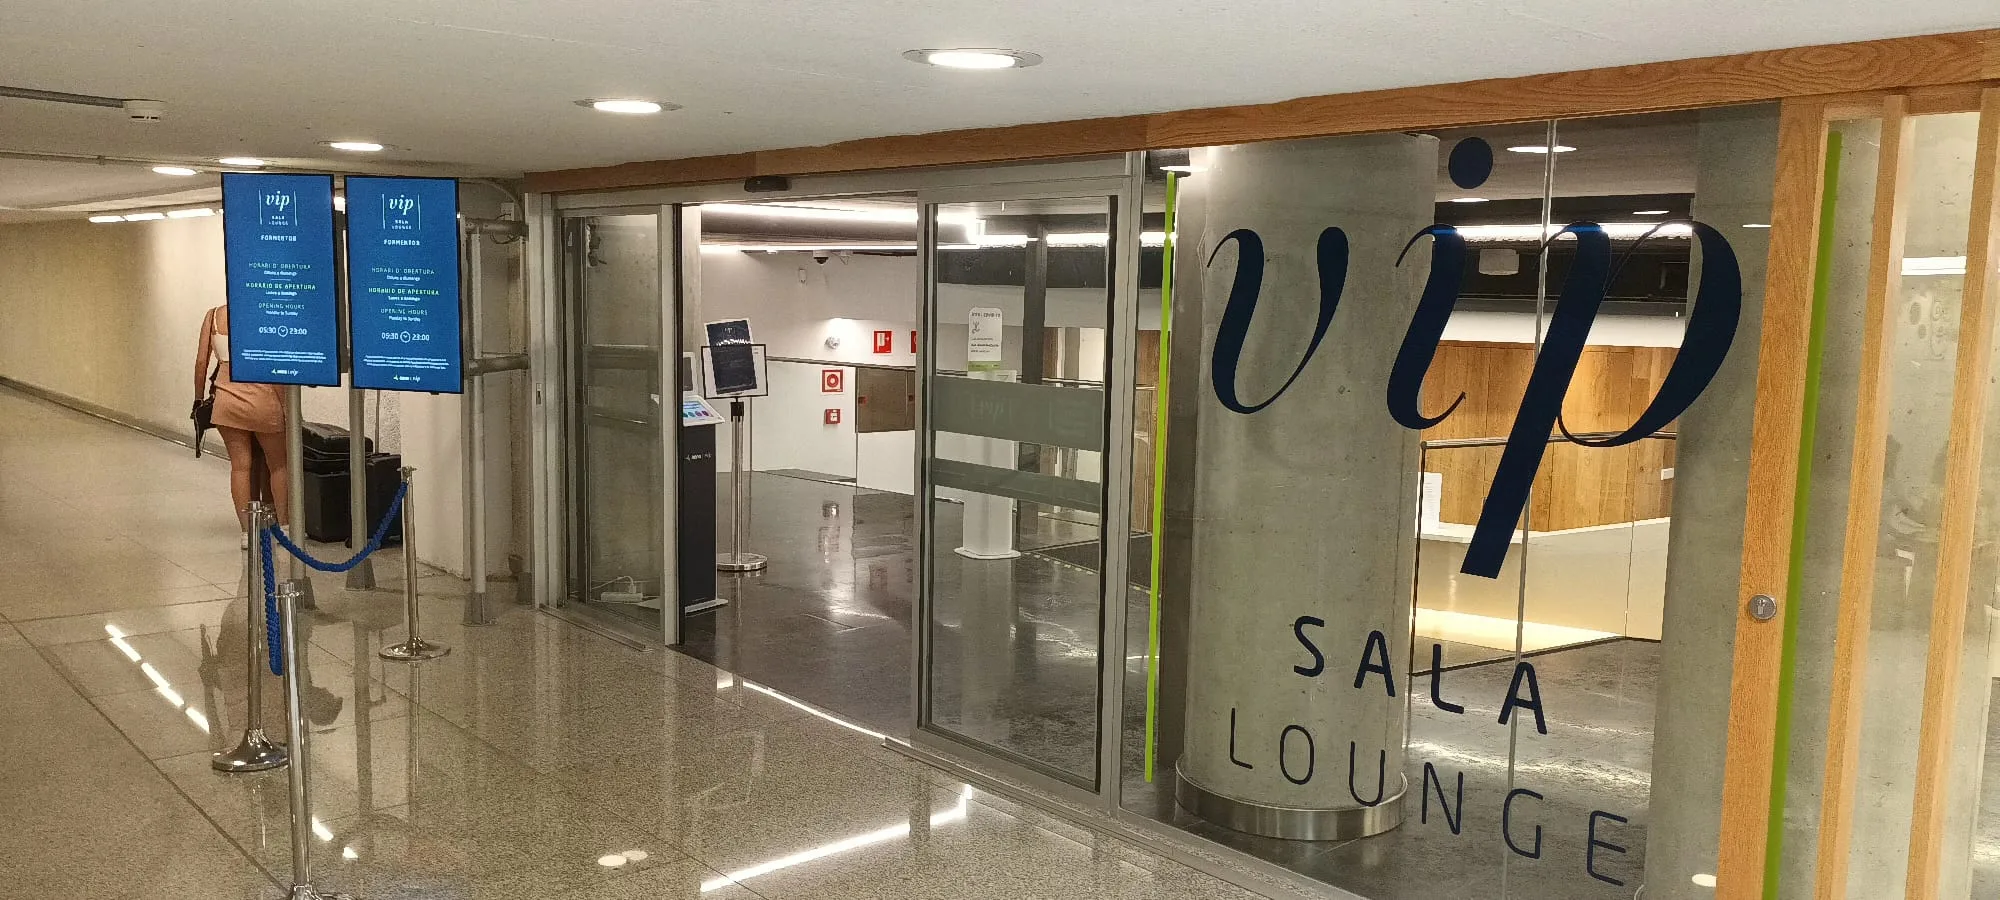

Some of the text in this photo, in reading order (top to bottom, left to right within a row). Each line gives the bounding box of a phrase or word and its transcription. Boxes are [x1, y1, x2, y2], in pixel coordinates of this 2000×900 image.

[265, 191, 290, 211] vip
[389, 194, 413, 215] vip
[259, 326, 276, 334] 05:30
[381, 332, 430, 341] 05:30 23:00
[1205, 137, 1742, 579] vip
[1292, 615, 1548, 736] SALA
[1229, 706, 1629, 887] LOUNGE
